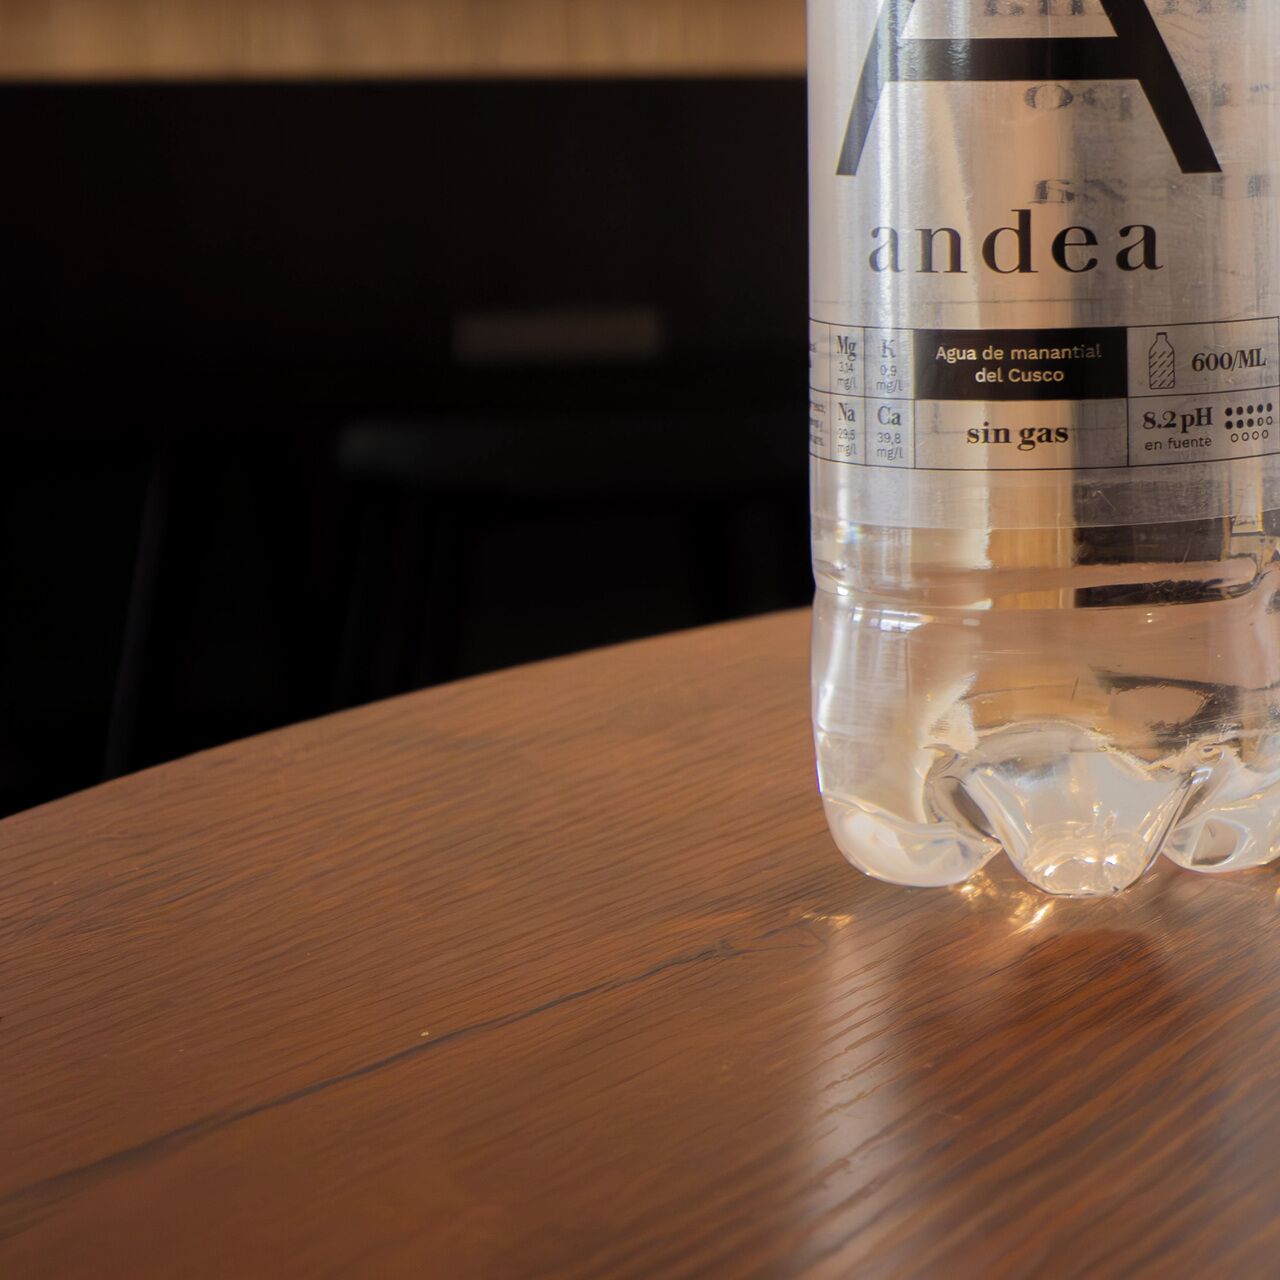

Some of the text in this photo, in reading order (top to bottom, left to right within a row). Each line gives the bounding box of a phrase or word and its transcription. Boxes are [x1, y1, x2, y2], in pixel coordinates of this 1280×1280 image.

[868, 209, 1164, 275] andea
[835, 335, 857, 362] Mg
[880, 339, 897, 359] K
[934, 344, 1103, 364] Agua de manantial
[1191, 347, 1268, 373] 600/ML
[974, 368, 1065, 383] del Cusco
[875, 380, 904, 394] mg/l
[838, 401, 856, 422] Na
[876, 405, 903, 427] Ca
[876, 431, 902, 446] 39,8
[966, 421, 1070, 452] sin gas
[1144, 435, 1213, 452] en fuente
[875, 446, 904, 461] mg/l
